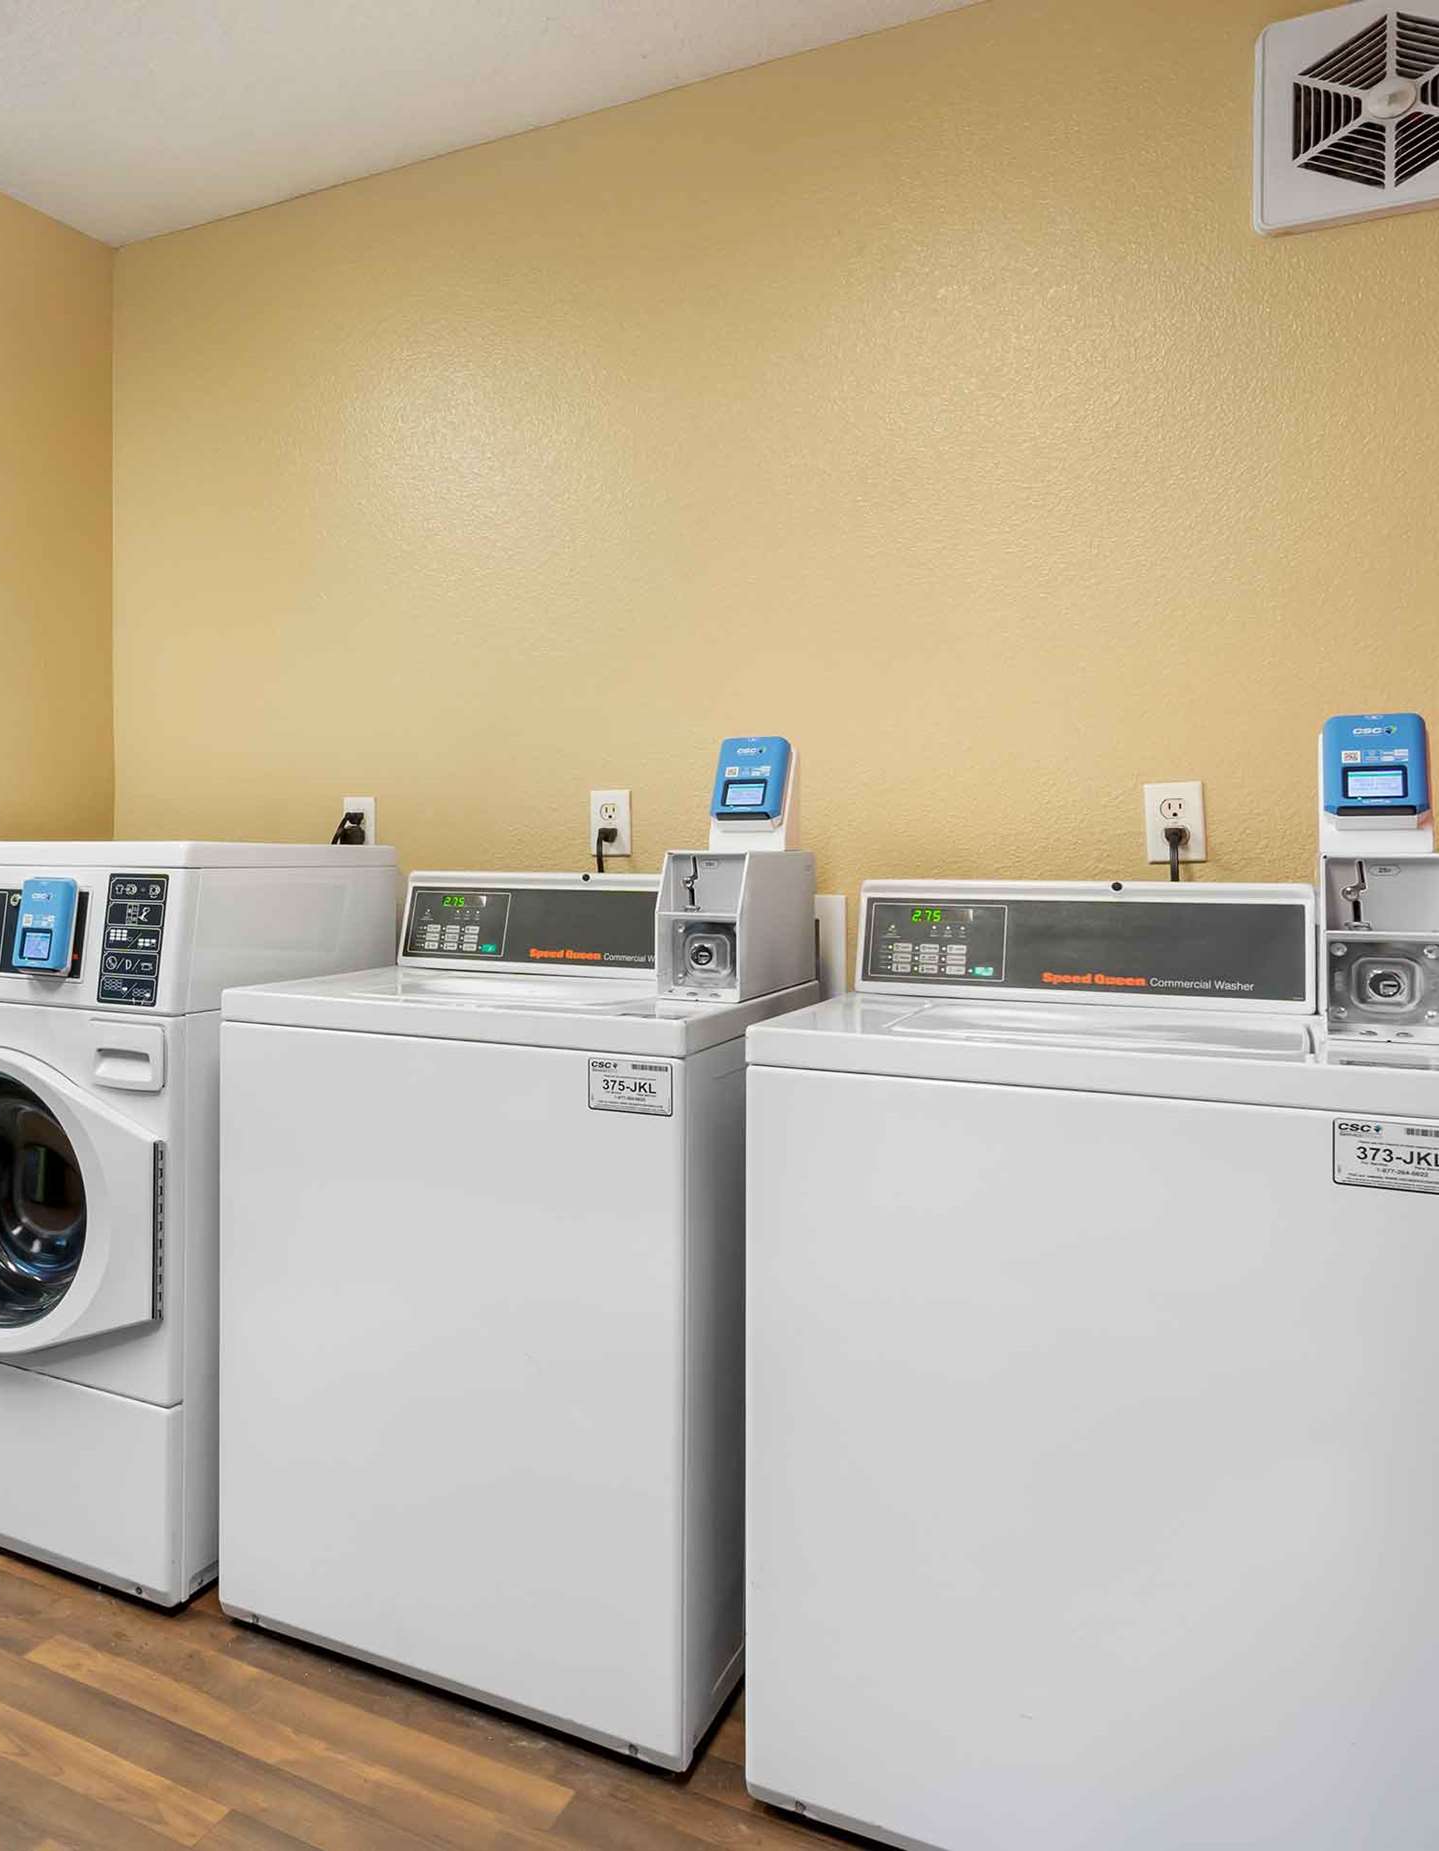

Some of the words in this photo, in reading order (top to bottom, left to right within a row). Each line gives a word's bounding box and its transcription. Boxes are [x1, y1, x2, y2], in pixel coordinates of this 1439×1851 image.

[529, 948, 564, 959] Speed
[565, 949, 601, 961] Queen
[603, 952, 646, 962] Commercial
[1041, 971, 1092, 985] Speed
[1094, 973, 1146, 987] Queen
[1149, 977, 1211, 989] Commercial
[1214, 980, 1255, 992] Washer
[591, 1060, 612, 1069] CSC
[602, 1079, 657, 1095] 375-JKL
[1338, 1122, 1372, 1133] CSC
